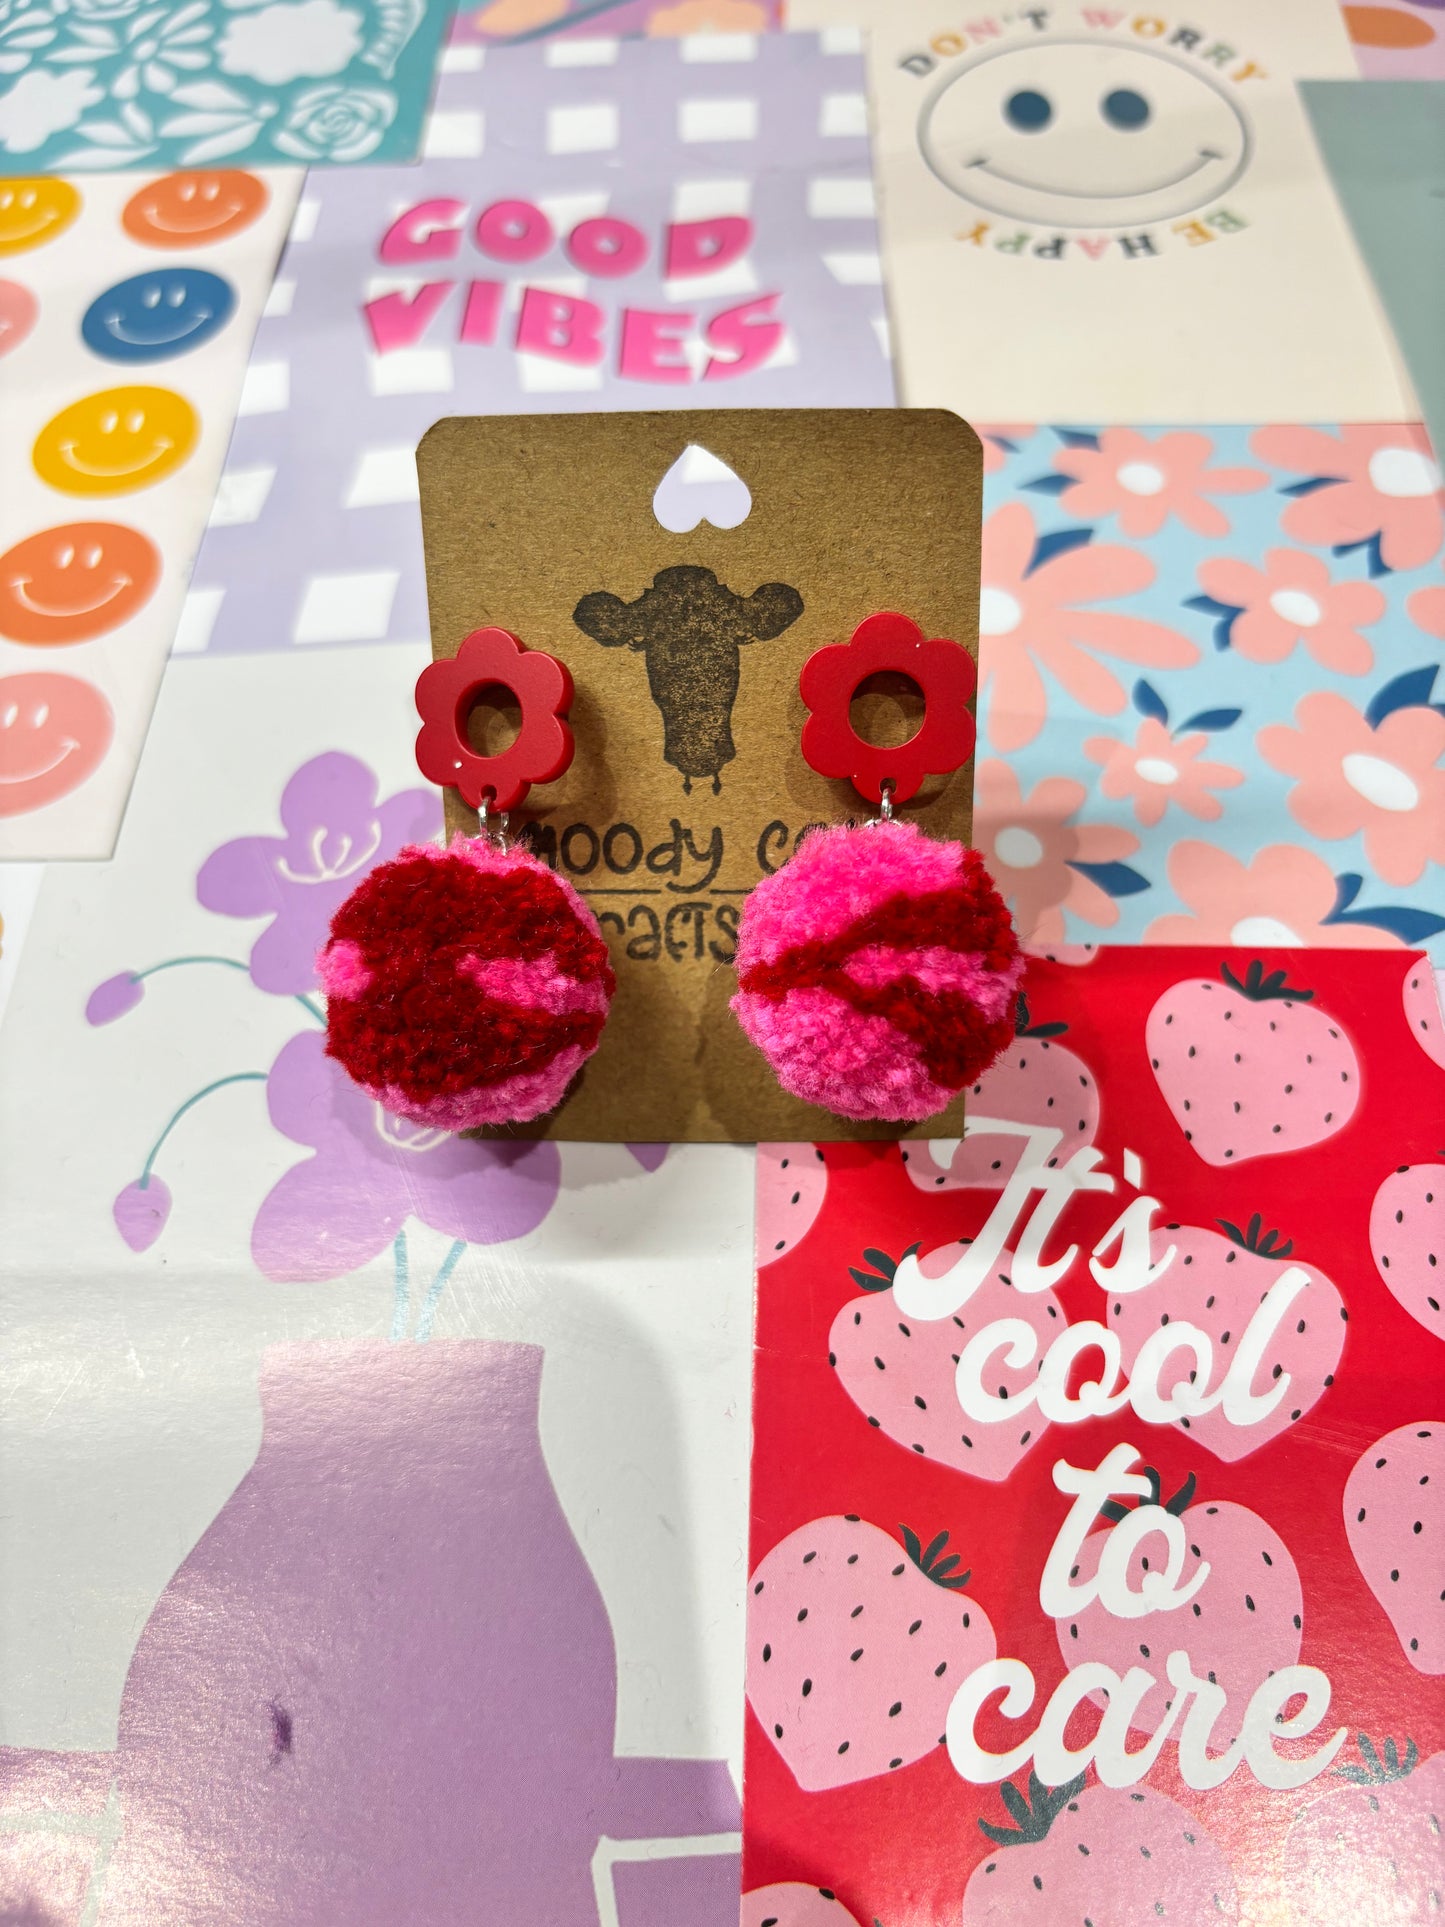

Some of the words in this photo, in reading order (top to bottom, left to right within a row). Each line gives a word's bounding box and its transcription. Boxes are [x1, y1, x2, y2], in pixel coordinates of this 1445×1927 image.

[897, 8, 1050, 79] DON'T
[1080, 8, 1268, 85] WORRY
[376, 197, 754, 281] GOOD
[955, 219, 1161, 261] HAPPY
[1172, 207, 1251, 247] BE
[361, 278, 782, 385] VIBES
[892, 1115, 1177, 1320] It's
[955, 1267, 1311, 1426] cool
[1038, 1441, 1210, 1619] to
[945, 1650, 1348, 1791] care
